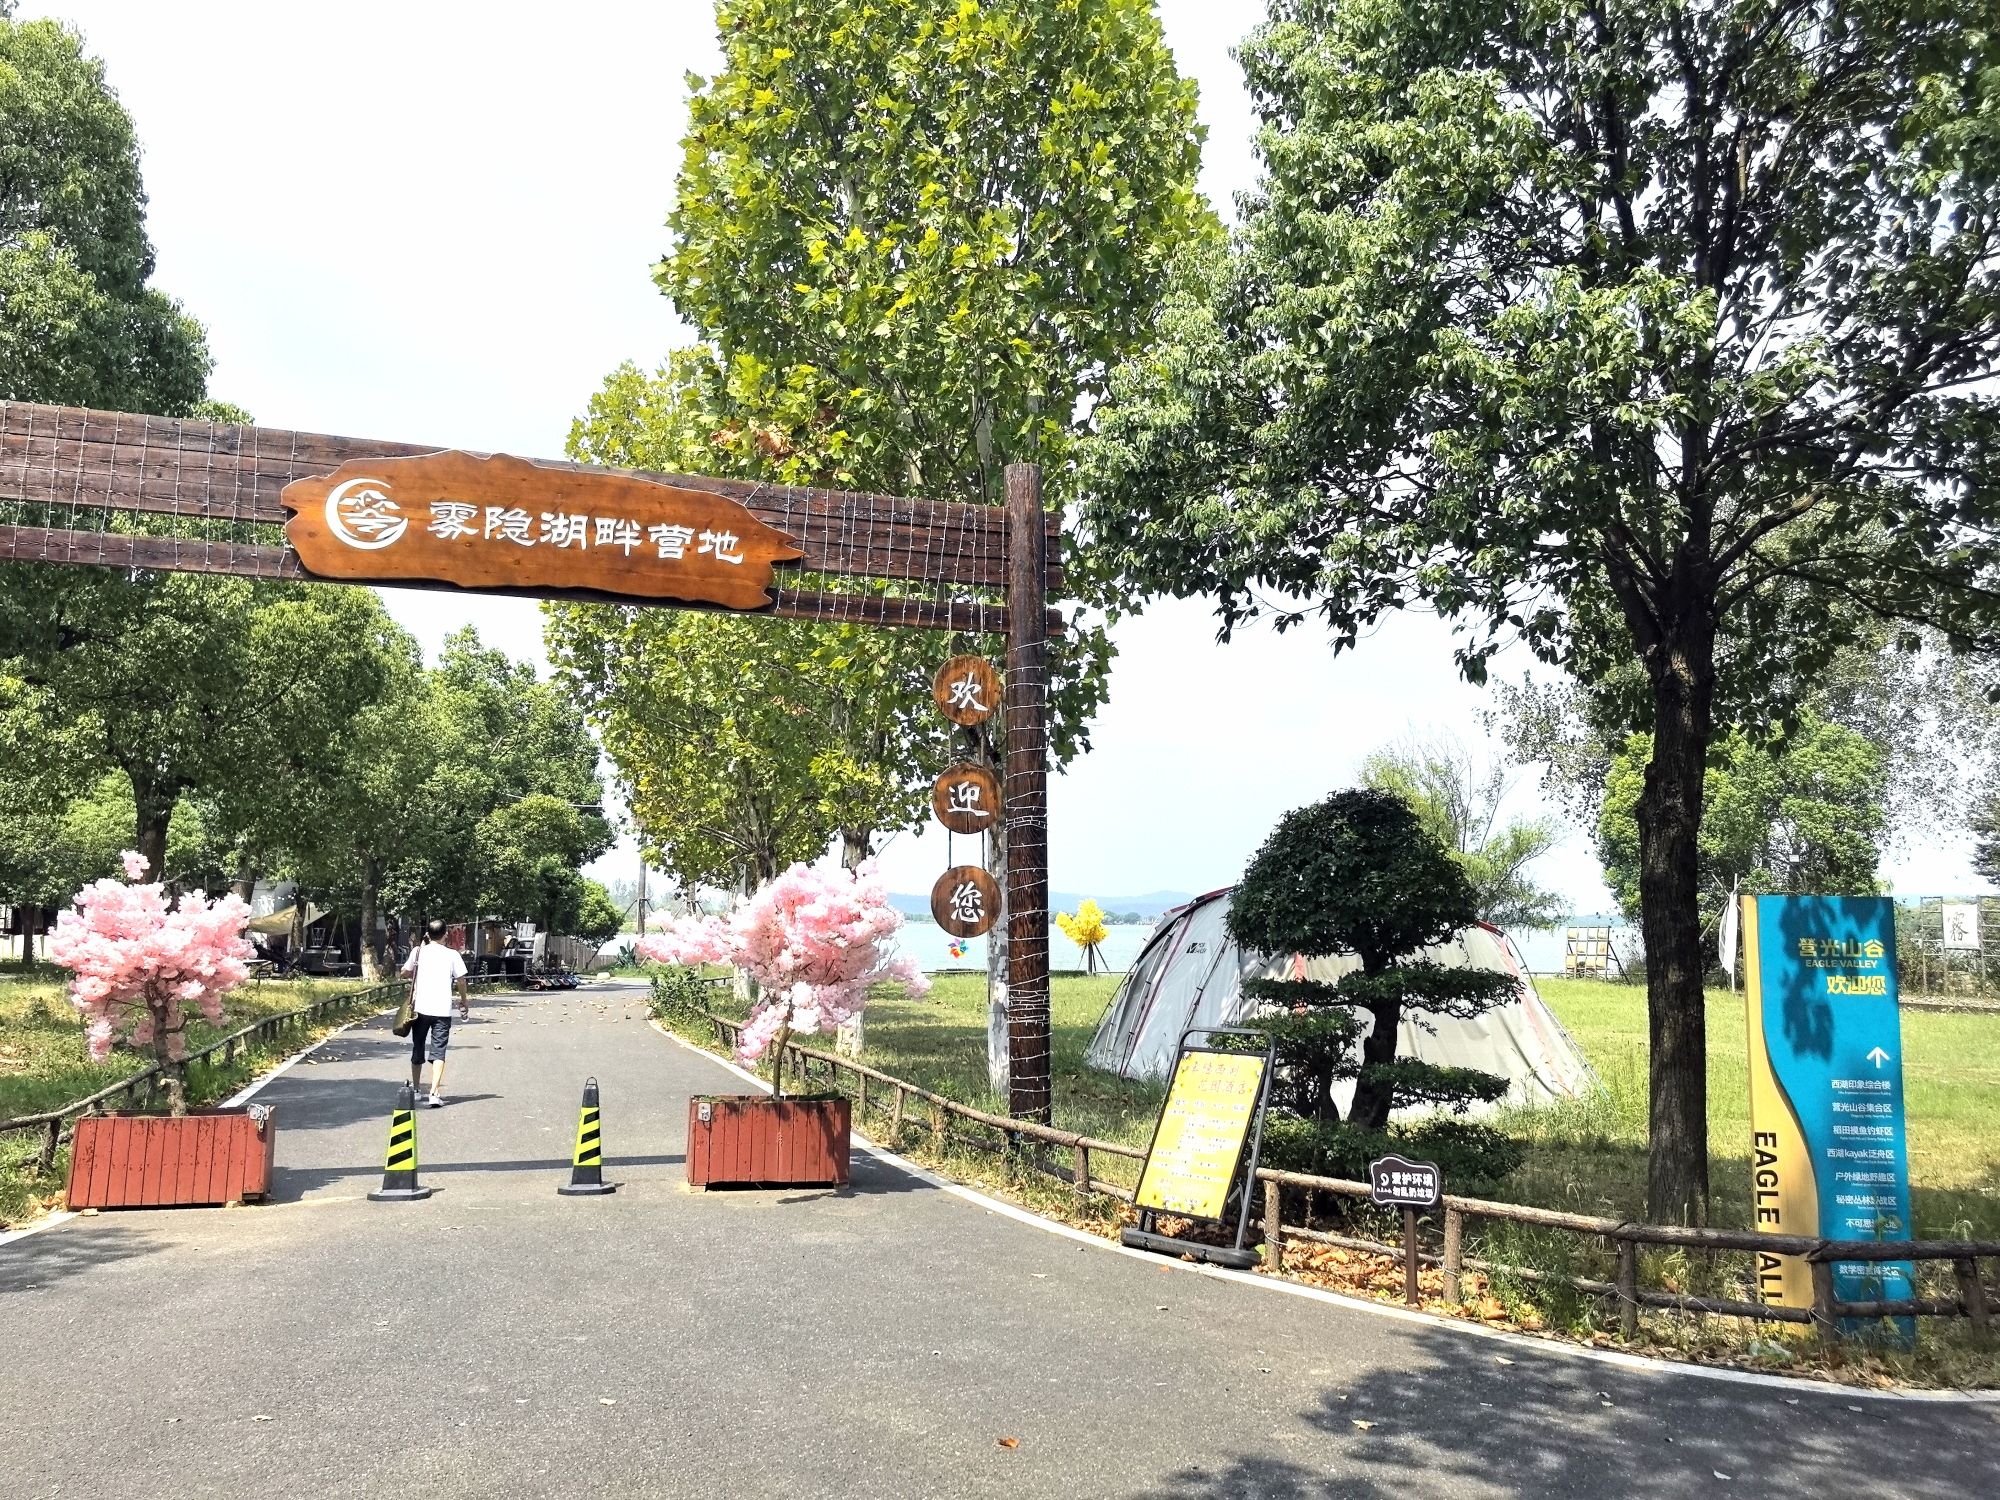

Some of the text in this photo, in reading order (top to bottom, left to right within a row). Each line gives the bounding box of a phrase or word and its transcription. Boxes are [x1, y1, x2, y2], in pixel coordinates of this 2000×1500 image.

[427, 500, 745, 565] 雾隐湖畔营地
[947, 671, 989, 711] 欢
[947, 780, 990, 817] 迎
[949, 881, 985, 923] 您
[1805, 959, 1878, 969] EAGLE VALLEY
[1826, 975, 1887, 996] 欢迎您
[1754, 1131, 1781, 1225] EAGLE
